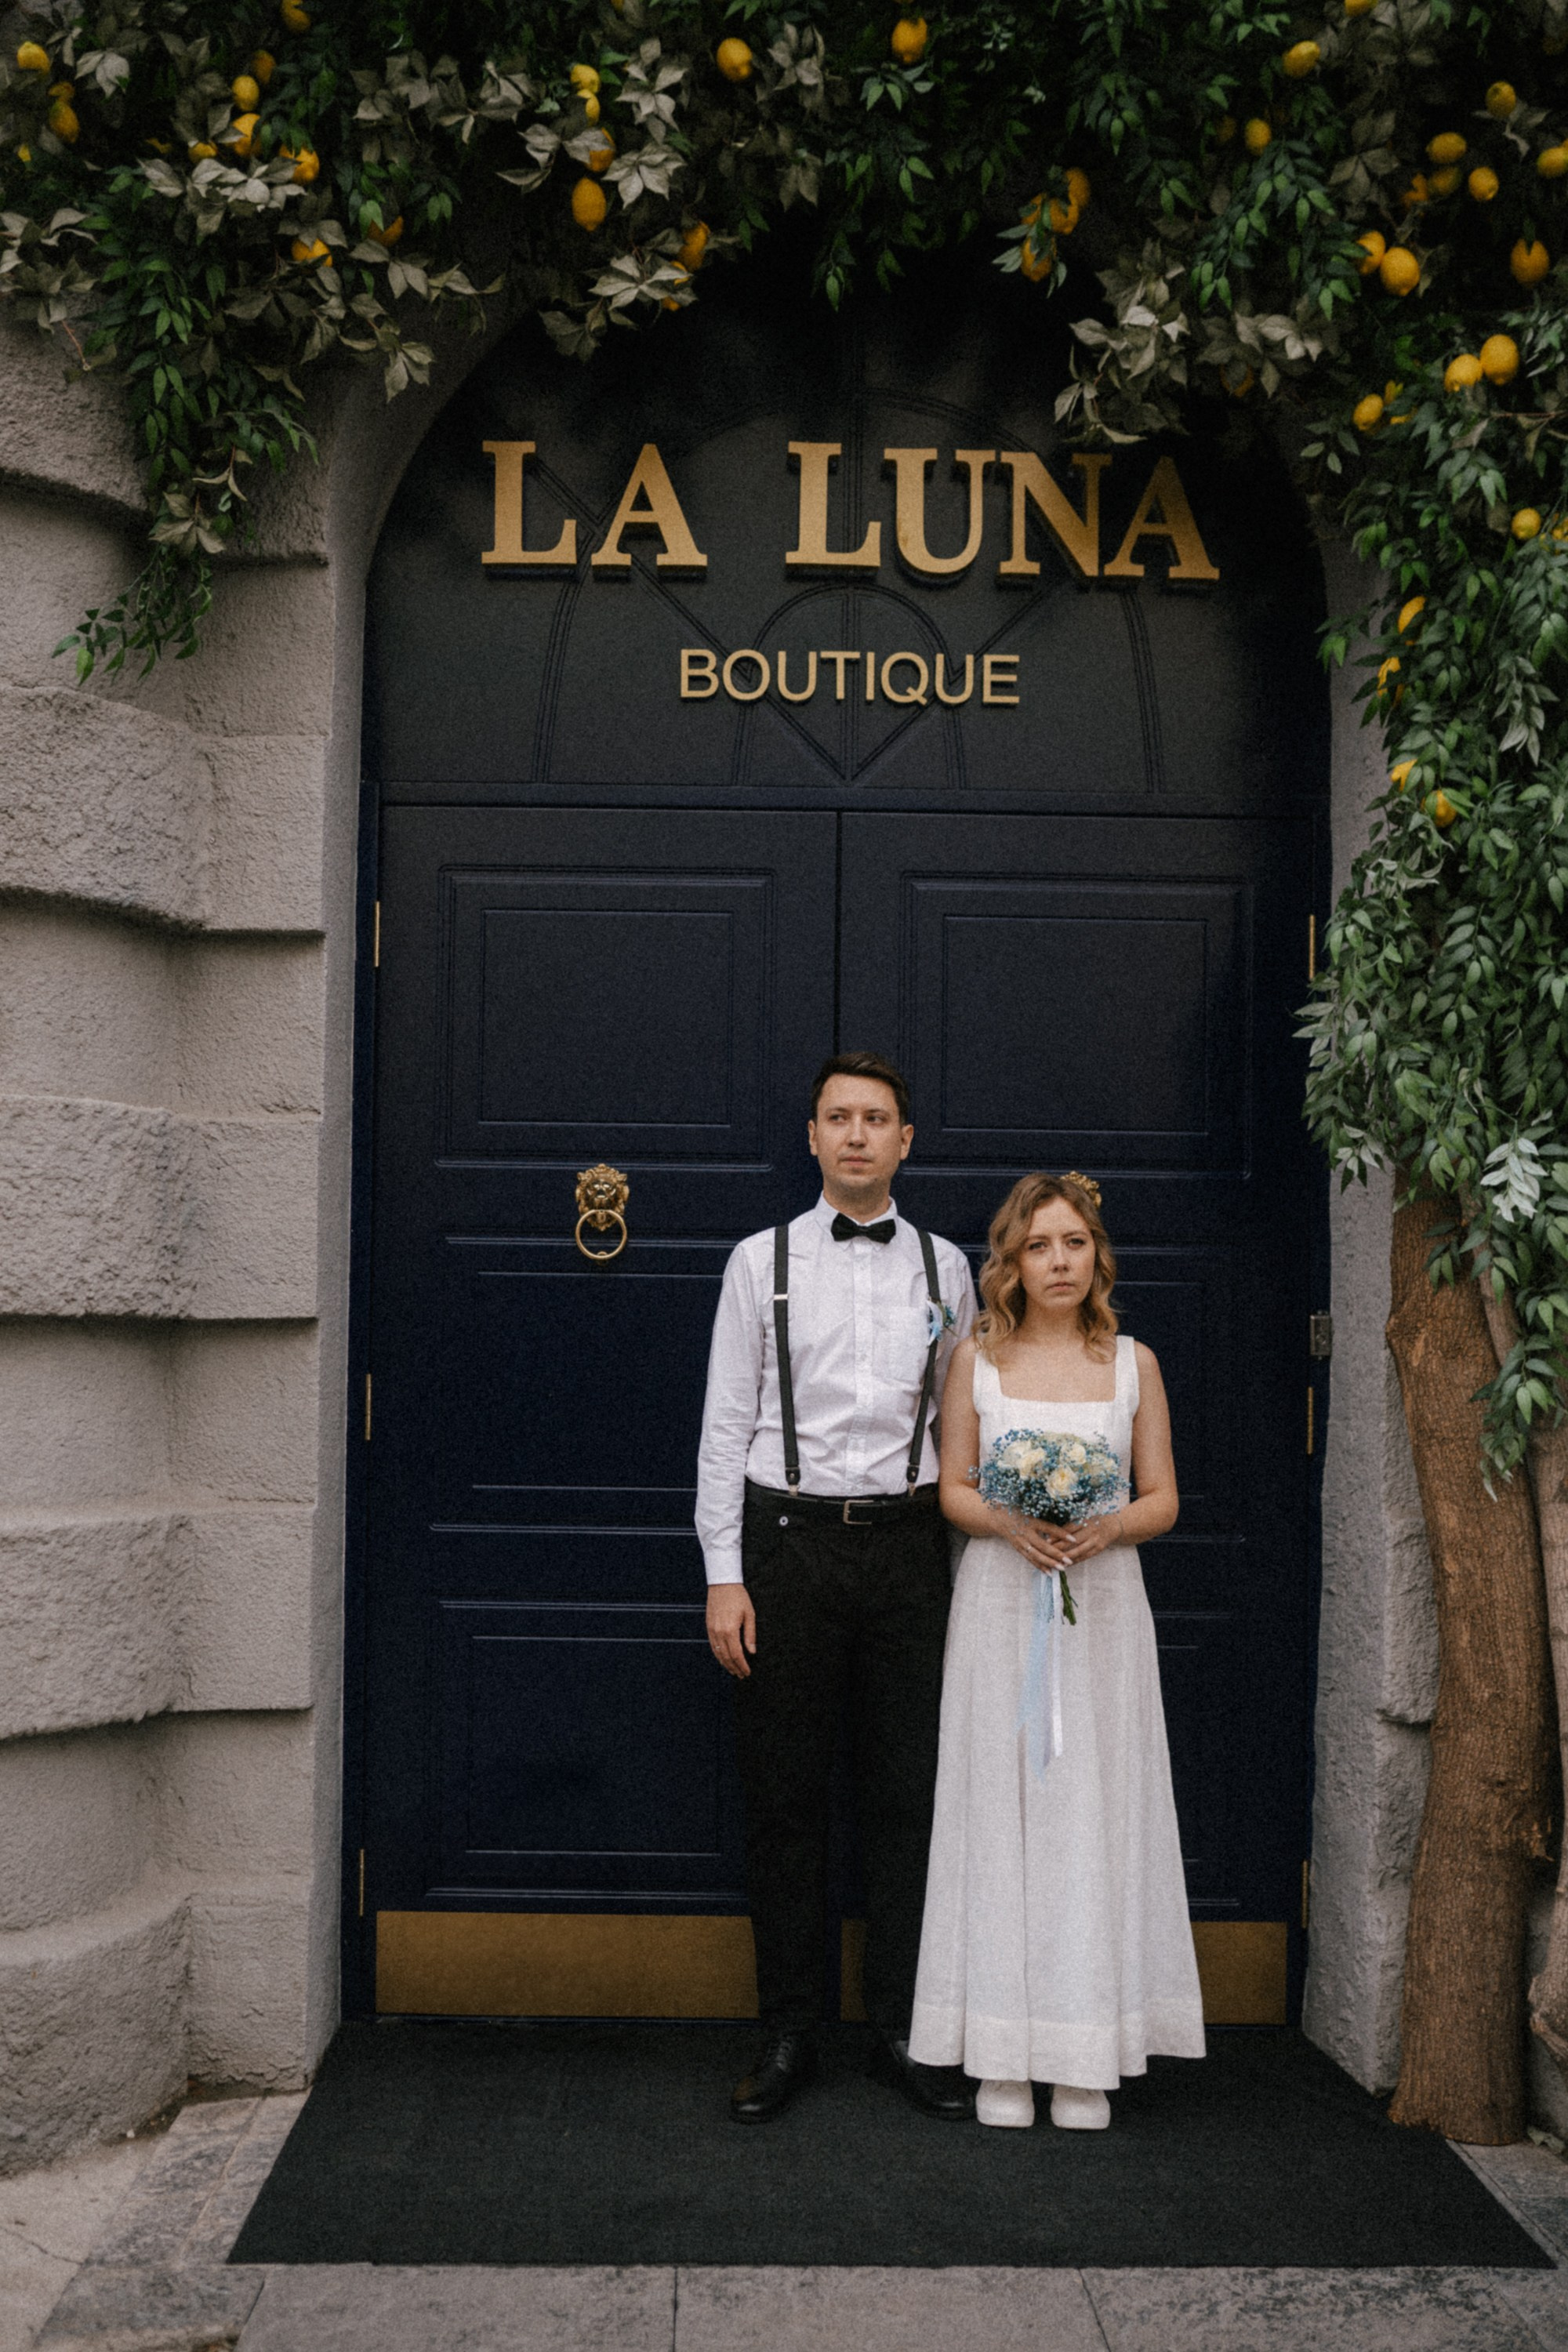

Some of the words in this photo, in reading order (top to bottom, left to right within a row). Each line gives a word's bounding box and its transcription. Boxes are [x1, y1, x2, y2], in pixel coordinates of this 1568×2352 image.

[481, 440, 708, 571] LA
[785, 440, 1220, 581] LUNA
[679, 648, 1021, 706] BOUTIQUE
